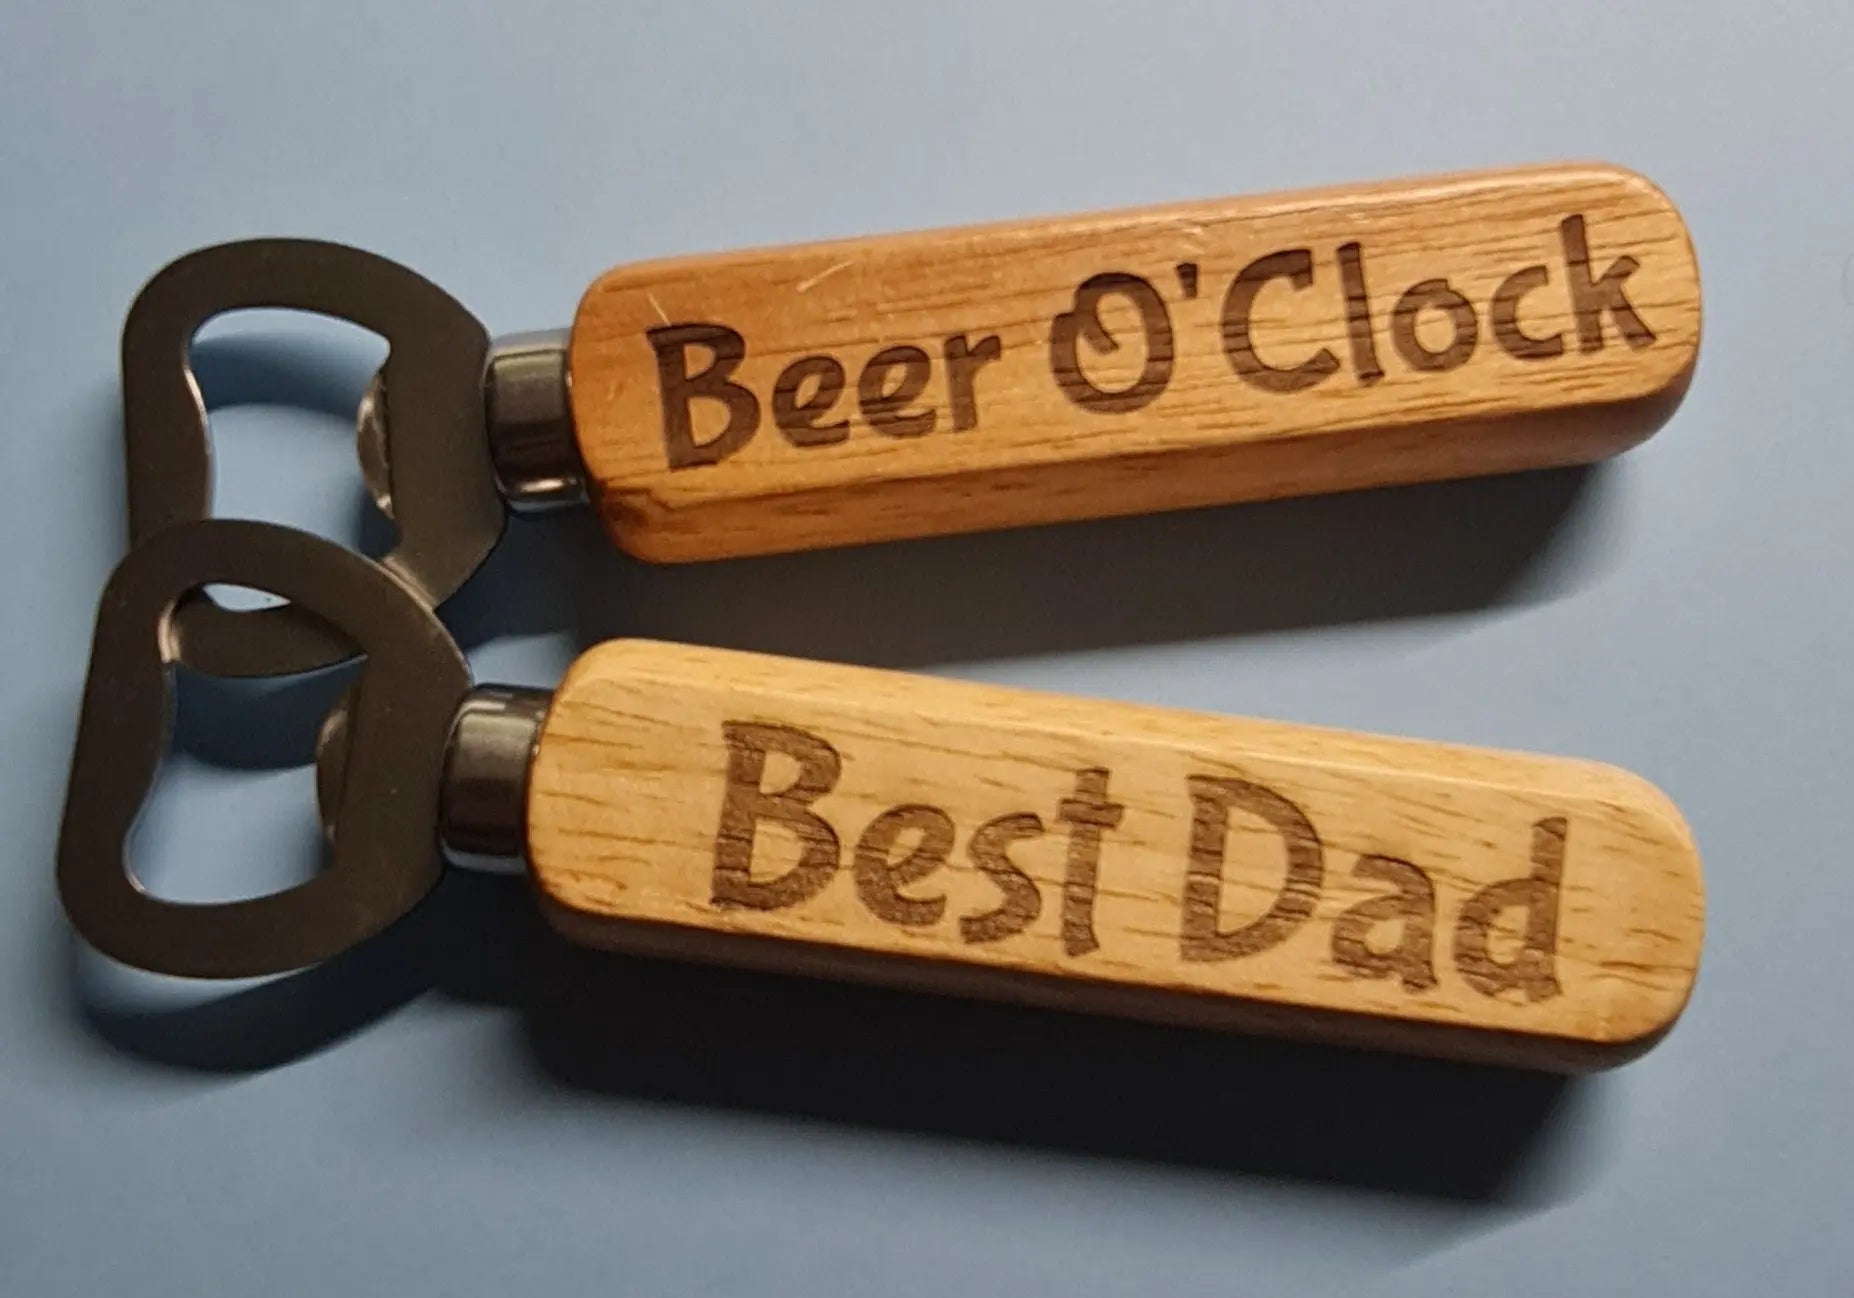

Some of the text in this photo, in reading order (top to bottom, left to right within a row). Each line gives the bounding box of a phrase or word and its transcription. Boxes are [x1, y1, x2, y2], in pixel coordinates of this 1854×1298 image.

[647, 213, 1657, 471] Beer O'Clock
[710, 719, 1568, 1004] Best Dad
